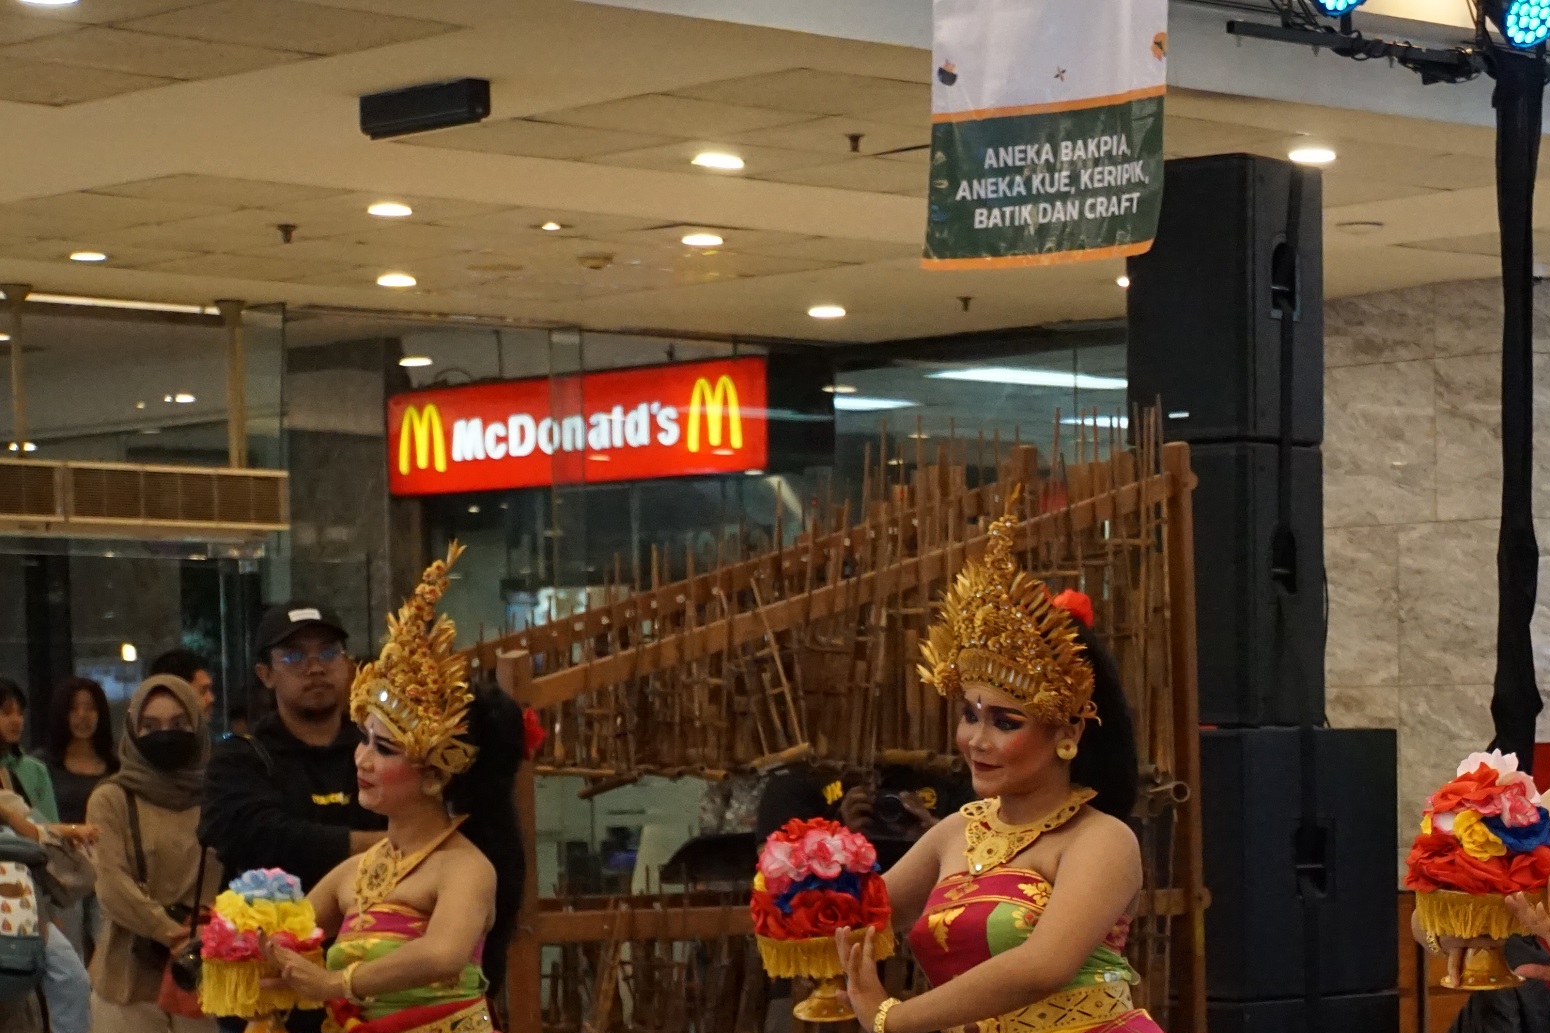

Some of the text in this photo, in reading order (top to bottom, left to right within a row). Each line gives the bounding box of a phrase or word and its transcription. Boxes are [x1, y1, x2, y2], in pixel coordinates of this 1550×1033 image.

[984, 142, 1055, 170] ANEKA
[955, 160, 1150, 201] ANEKA KUE, KERIPIK,
[973, 192, 1142, 230] BATIK DAN CRAFT
[451, 401, 681, 463] McDonald's
